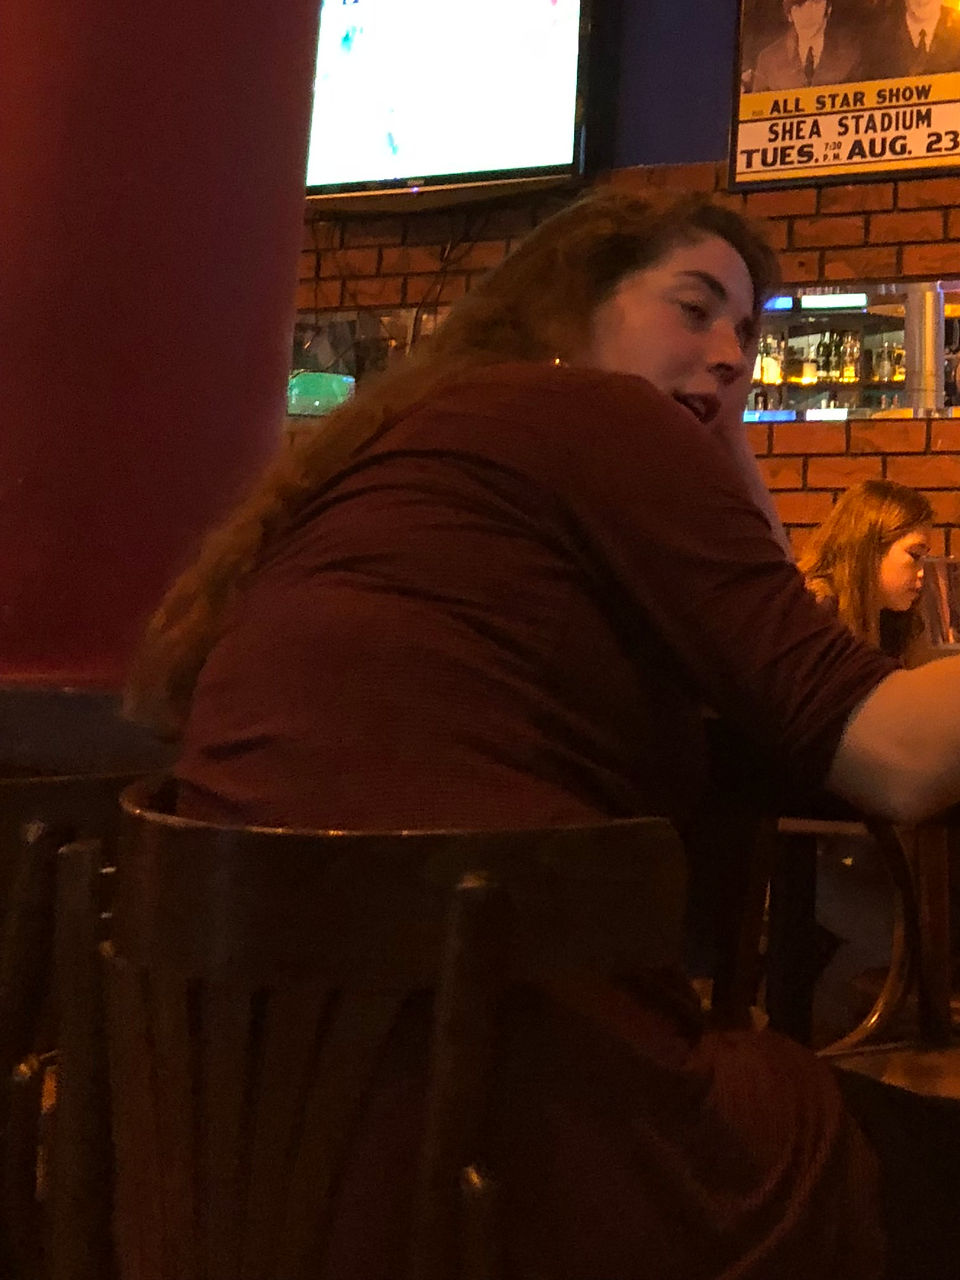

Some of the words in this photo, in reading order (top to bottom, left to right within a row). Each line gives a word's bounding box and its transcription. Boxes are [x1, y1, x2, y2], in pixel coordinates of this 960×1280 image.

[770, 99, 806, 116] ALL
[815, 91, 866, 111] STAR
[876, 84, 932, 104] SHOW
[768, 119, 822, 143] SHEA
[838, 108, 933, 137] STADIUM
[740, 143, 819, 169] TUES.
[847, 135, 913, 161] AUG.
[926, 130, 960, 154] 23
[824, 141, 842, 151] 7:30
